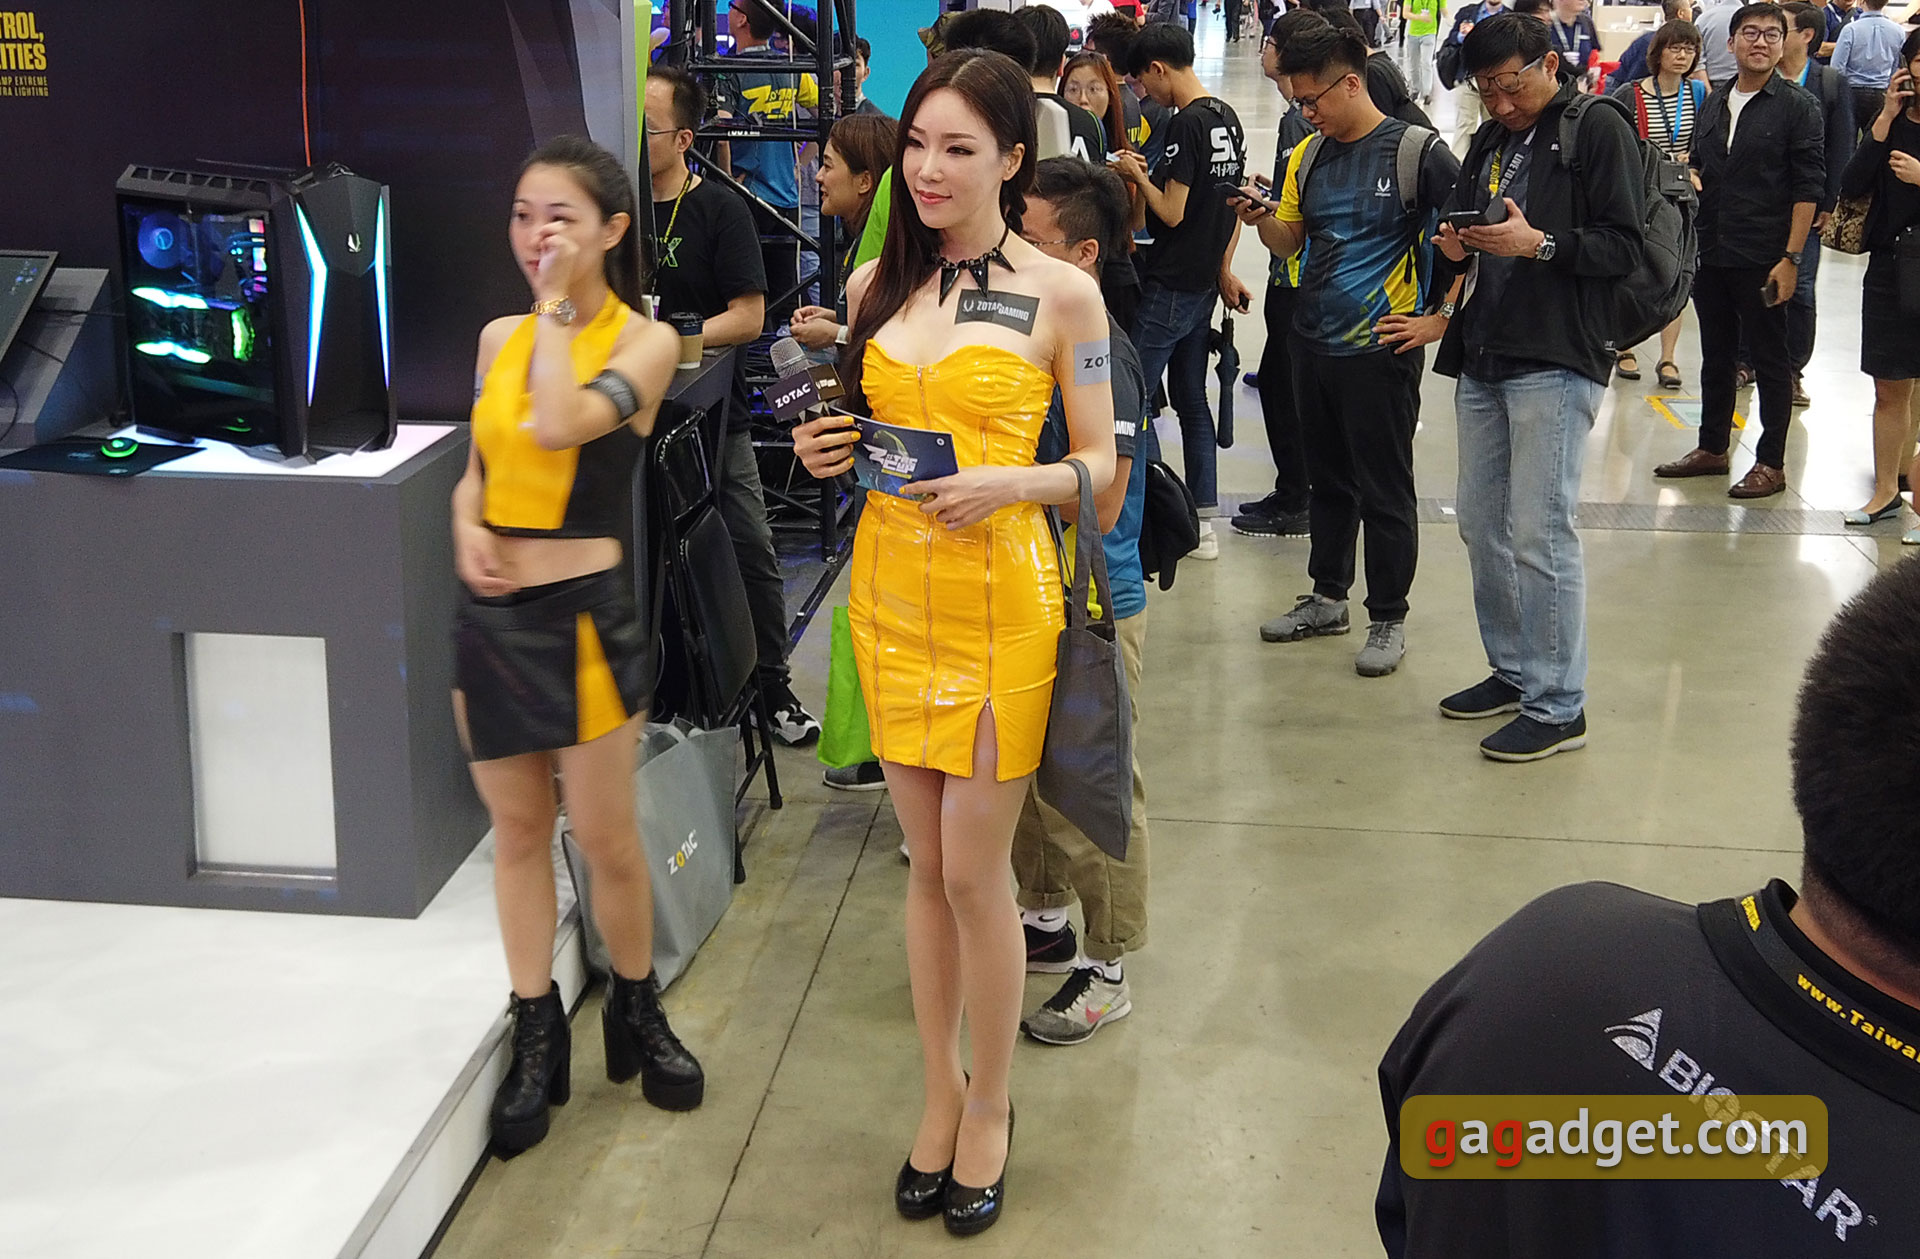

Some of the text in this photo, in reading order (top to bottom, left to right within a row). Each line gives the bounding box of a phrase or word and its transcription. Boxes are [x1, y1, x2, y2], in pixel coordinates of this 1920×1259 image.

[0, 11, 44, 42] ROL,
[14, 76, 48, 86] EXTREME
[14, 86, 49, 97] LIGHTING
[774, 383, 811, 409] ZOTAC
[667, 830, 698, 875] ZOTAC
